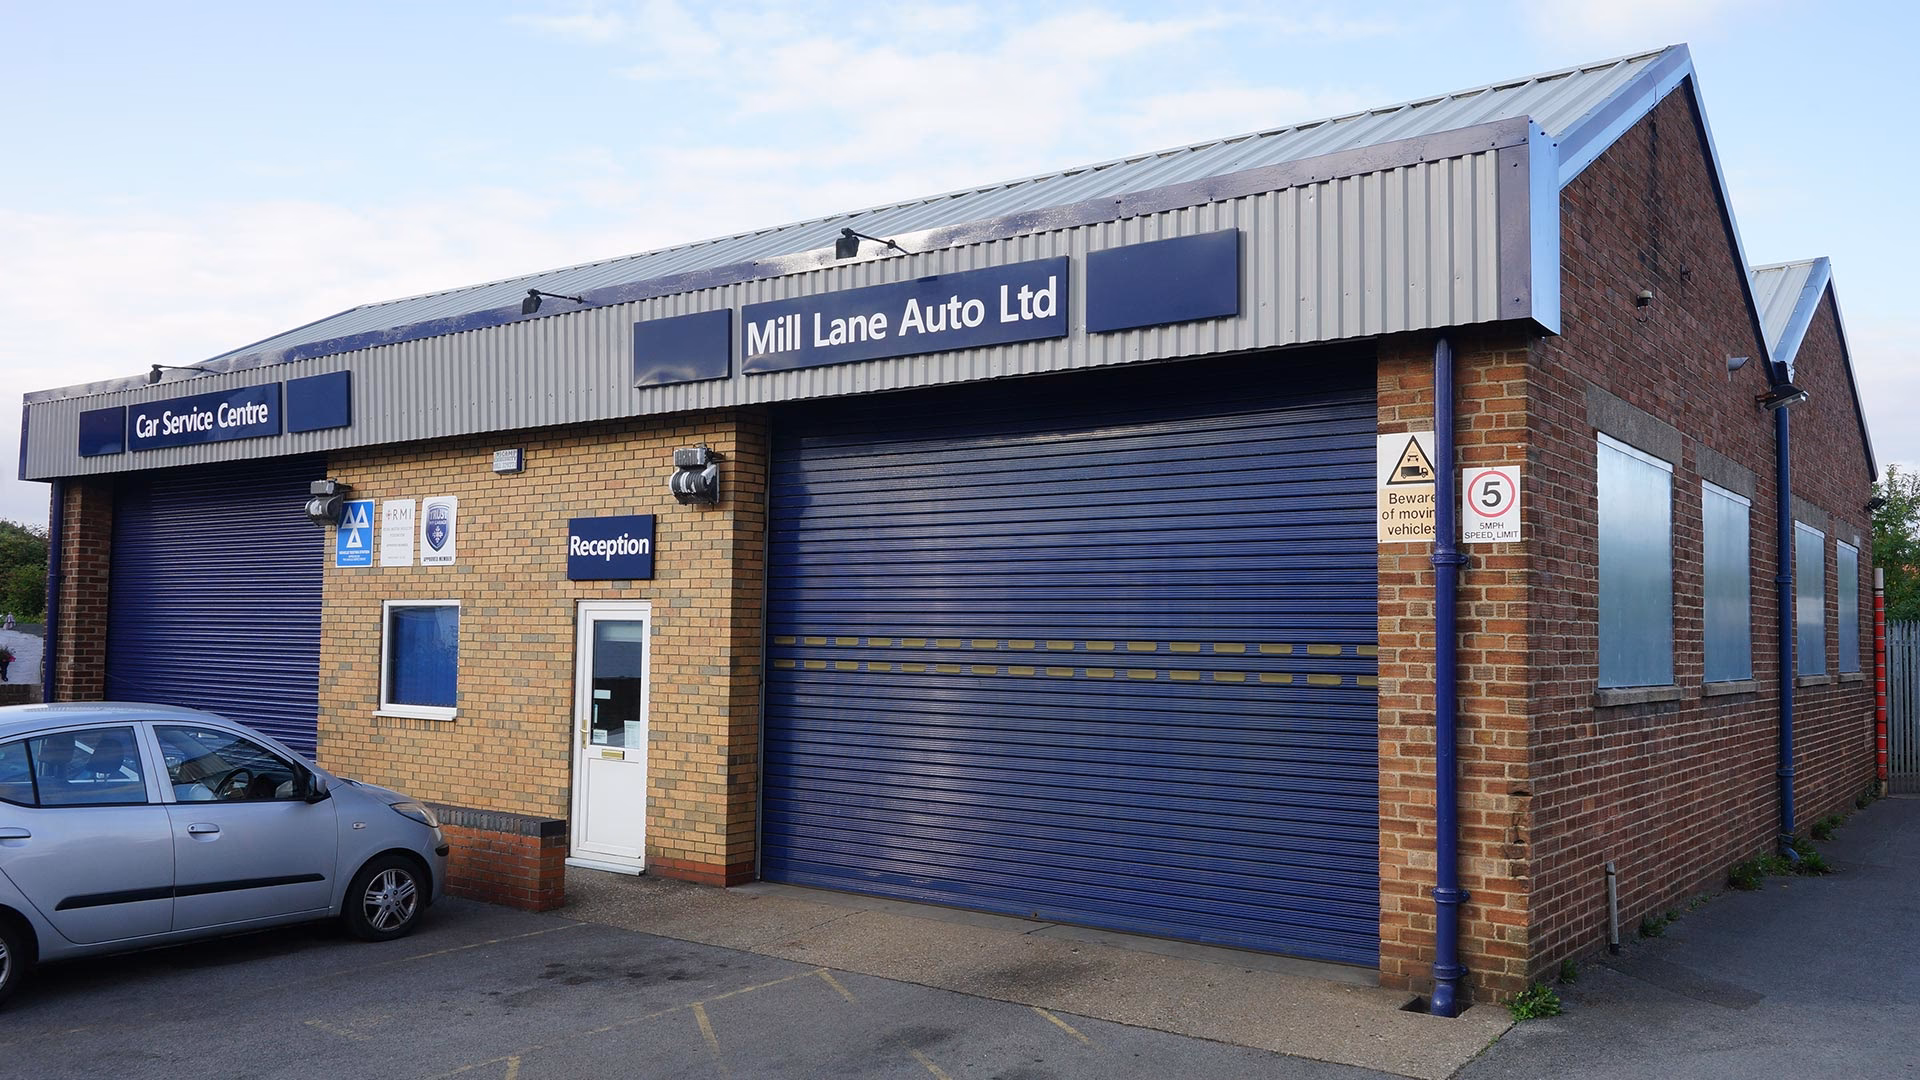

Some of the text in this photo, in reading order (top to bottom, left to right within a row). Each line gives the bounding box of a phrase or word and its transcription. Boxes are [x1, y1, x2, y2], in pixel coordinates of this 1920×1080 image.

[747, 276, 1057, 356] Mill Lane Auto Ltd
[136, 401, 268, 438] Car Service Centre
[1389, 493, 1436, 505] Beware
[1481, 481, 1502, 507] 5
[392, 508, 412, 520] RMI
[1381, 506, 1436, 520] of movin
[1479, 522, 1504, 530] 5MPH
[1464, 531, 1519, 540] SPEED LIMIT
[570, 533, 650, 561] Reception
